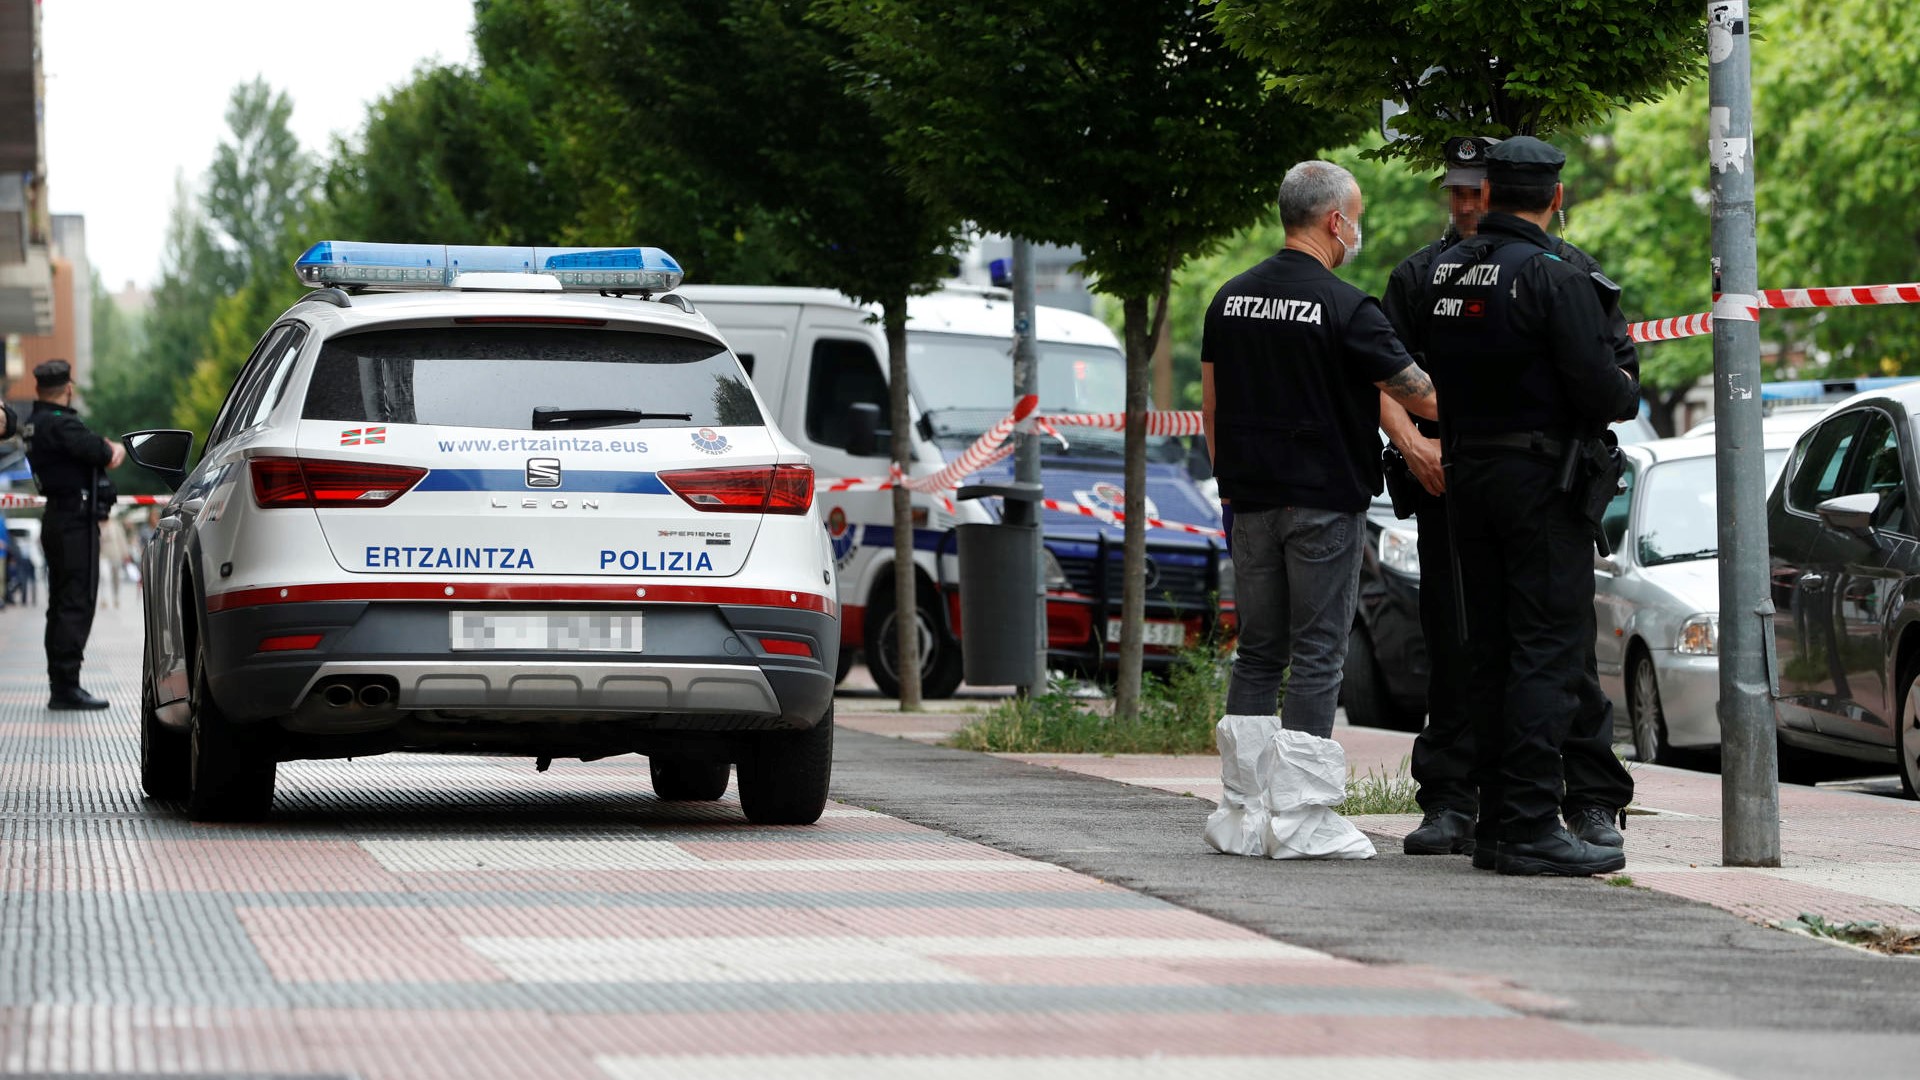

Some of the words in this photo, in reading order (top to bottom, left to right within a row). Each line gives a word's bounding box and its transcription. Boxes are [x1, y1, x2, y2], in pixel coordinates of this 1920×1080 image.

[1432, 263, 1500, 285] ERTAINTZA
[1223, 296, 1321, 325] ERTZAINTZA
[438, 437, 649, 453] www.ertzaintza.eus
[491, 497, 599, 509] LEON
[366, 546, 535, 569] ERTZAINTZA
[600, 550, 713, 571] POLIZIA
